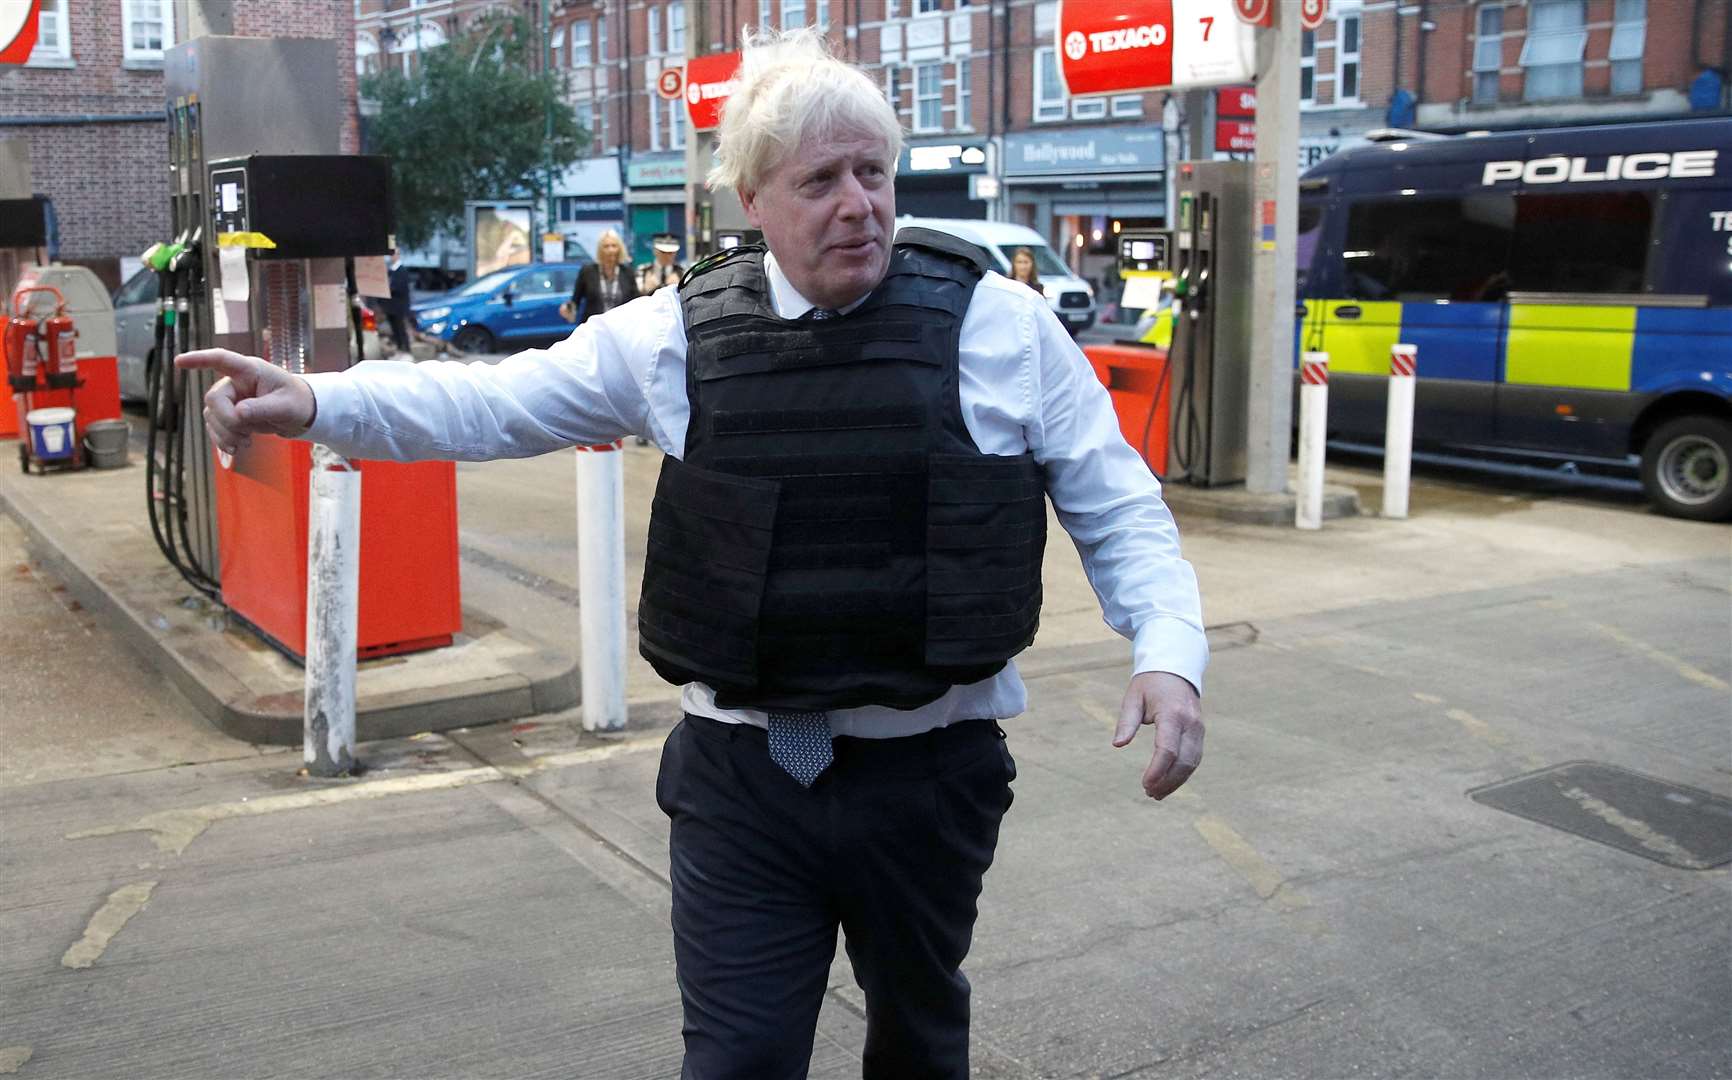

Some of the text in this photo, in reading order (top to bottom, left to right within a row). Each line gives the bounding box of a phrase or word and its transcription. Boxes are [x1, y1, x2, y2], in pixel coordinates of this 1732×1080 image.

[1089, 24, 1166, 53] TEXACO
[1199, 17, 1214, 41] 7
[1482, 150, 1718, 186] POLICE
